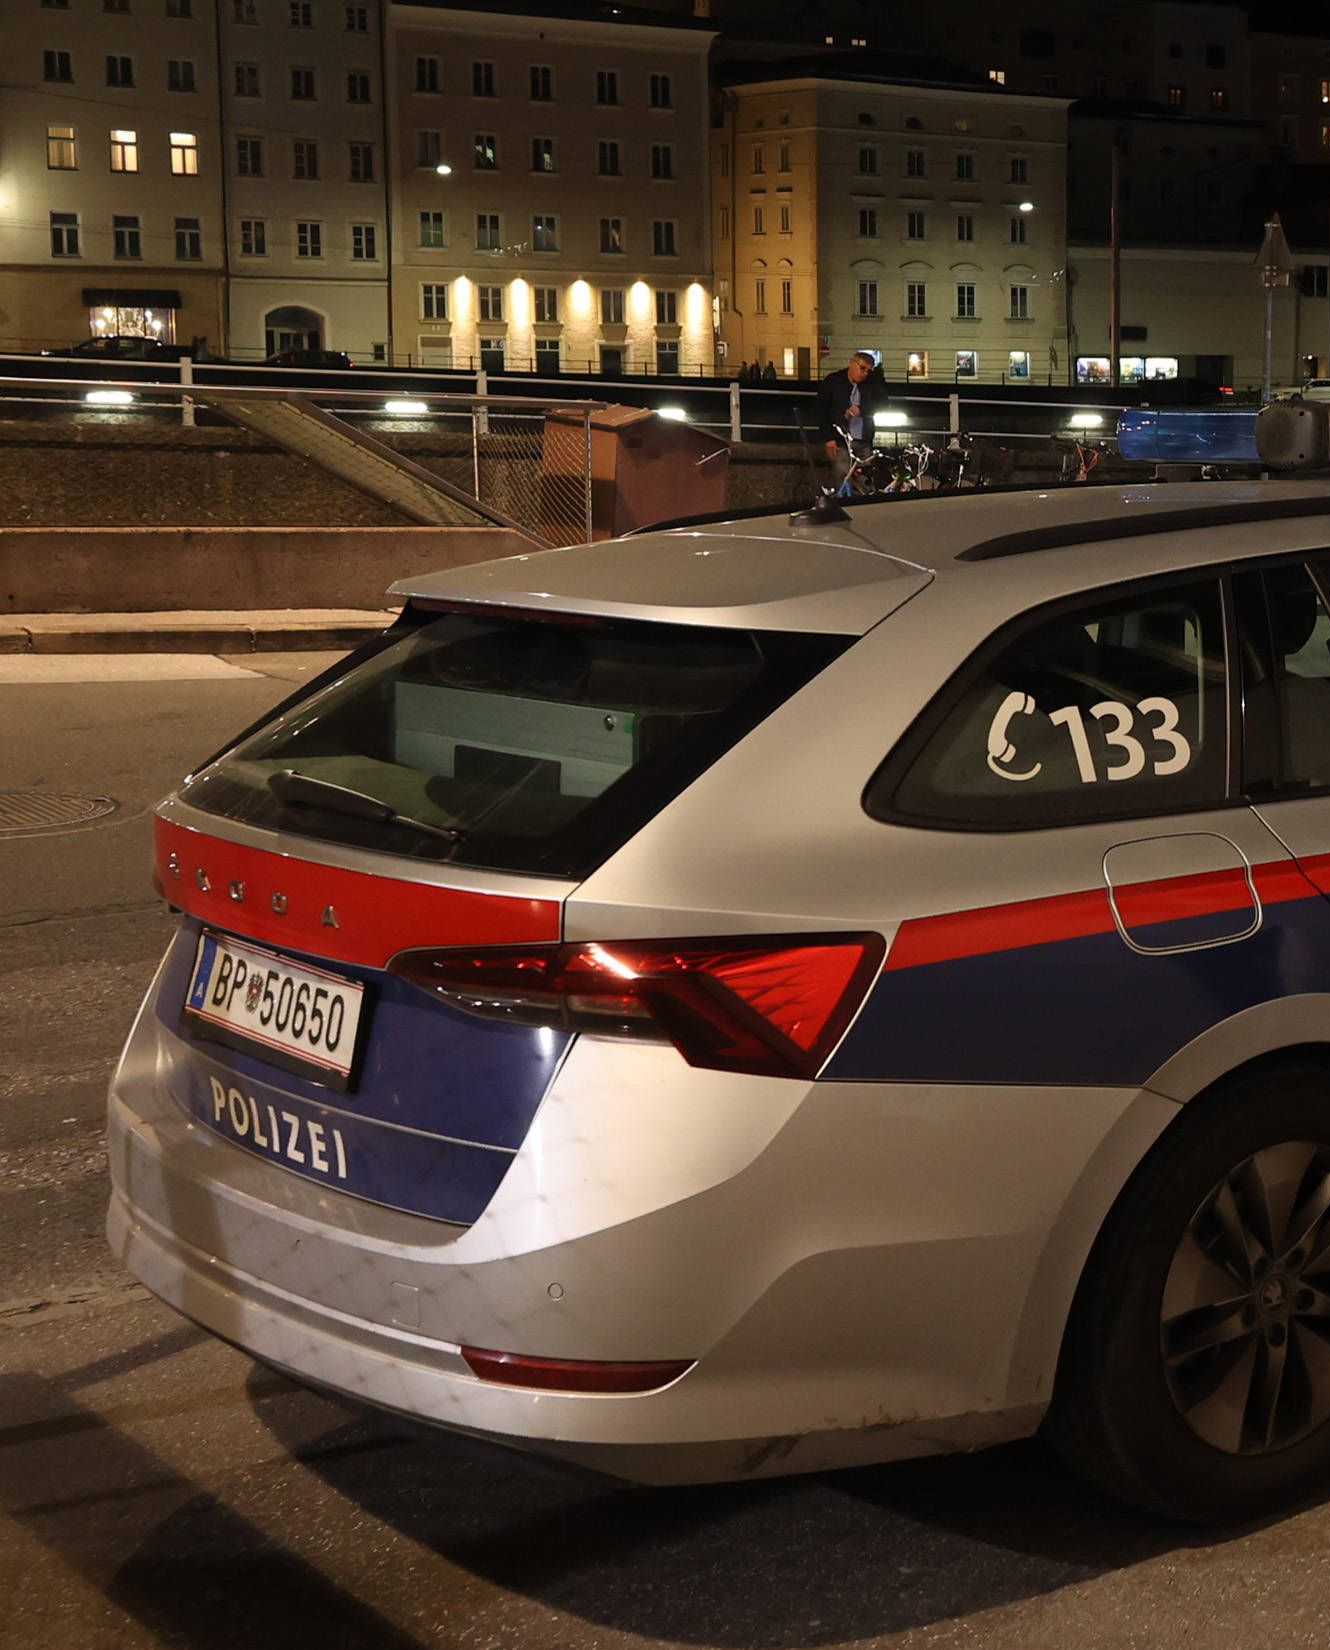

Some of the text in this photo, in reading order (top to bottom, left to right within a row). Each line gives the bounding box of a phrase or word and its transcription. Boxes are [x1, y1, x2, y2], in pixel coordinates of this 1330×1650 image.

[1048, 696, 1191, 783] 133
[212, 953, 345, 1053] BP 50650
[210, 1076, 347, 1179] POLIZEI
